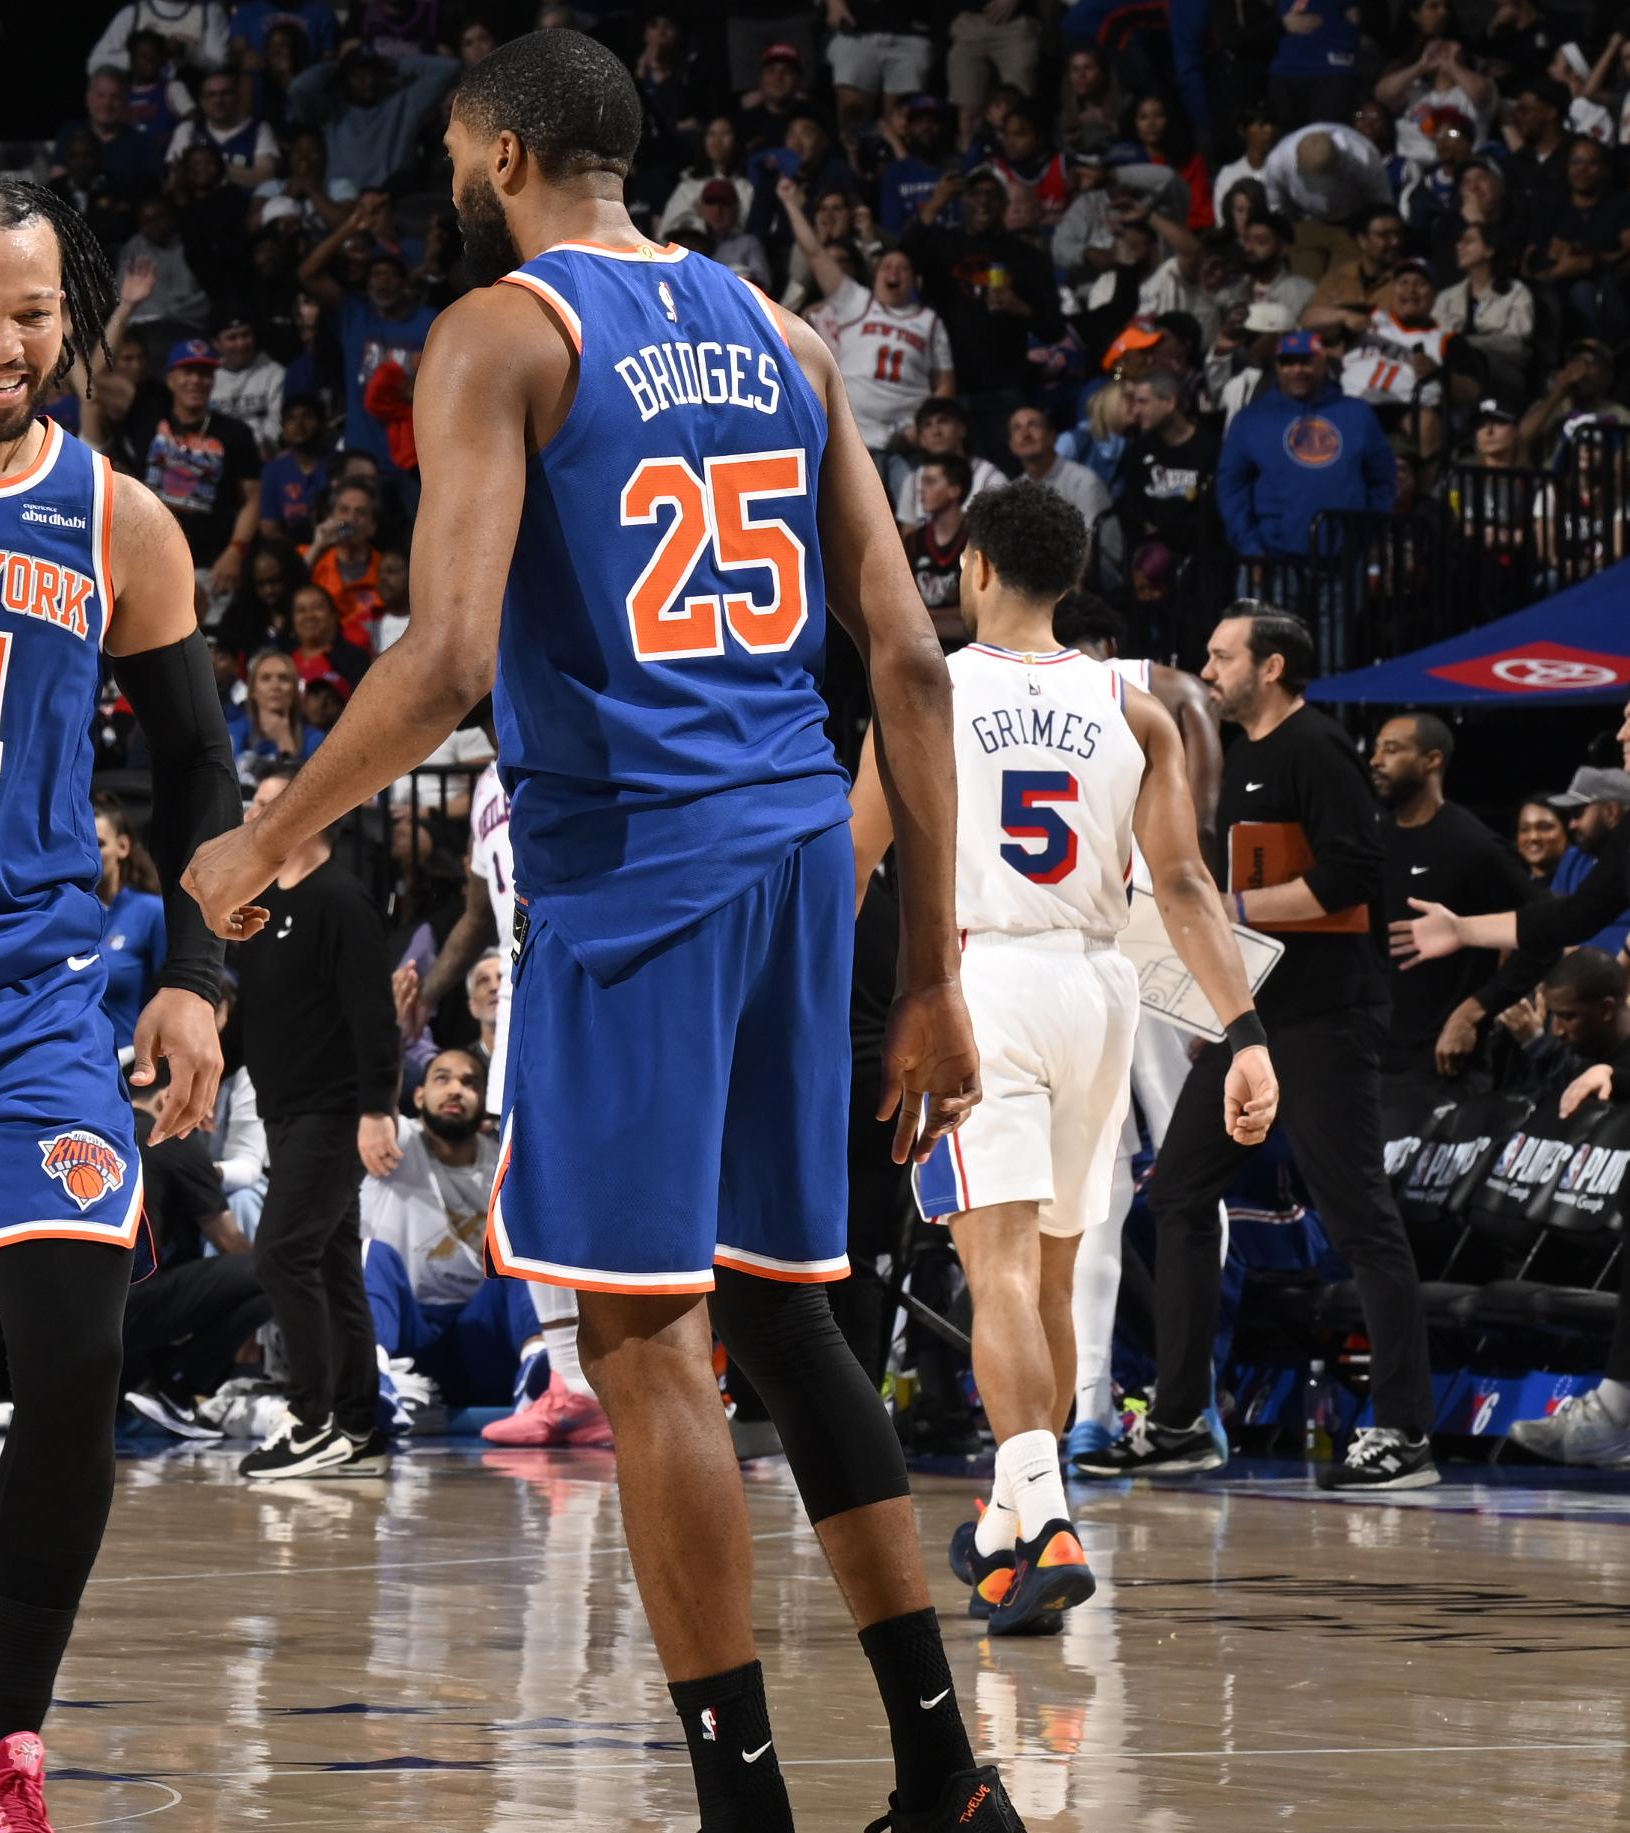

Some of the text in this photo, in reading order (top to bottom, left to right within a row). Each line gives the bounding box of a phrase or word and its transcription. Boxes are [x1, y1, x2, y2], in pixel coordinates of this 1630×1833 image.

[614, 341, 780, 422] BRIDGES
[873, 344, 904, 384] 11
[1368, 360, 1400, 391] 11
[21, 509, 87, 530] abu dhabi
[620, 448, 809, 662] 25
[971, 708, 1102, 760] GRIMES
[1000, 769, 1079, 885] 5
[44, 1136, 122, 1188] KNICKS
[958, 1782, 992, 1825] TWELVE
